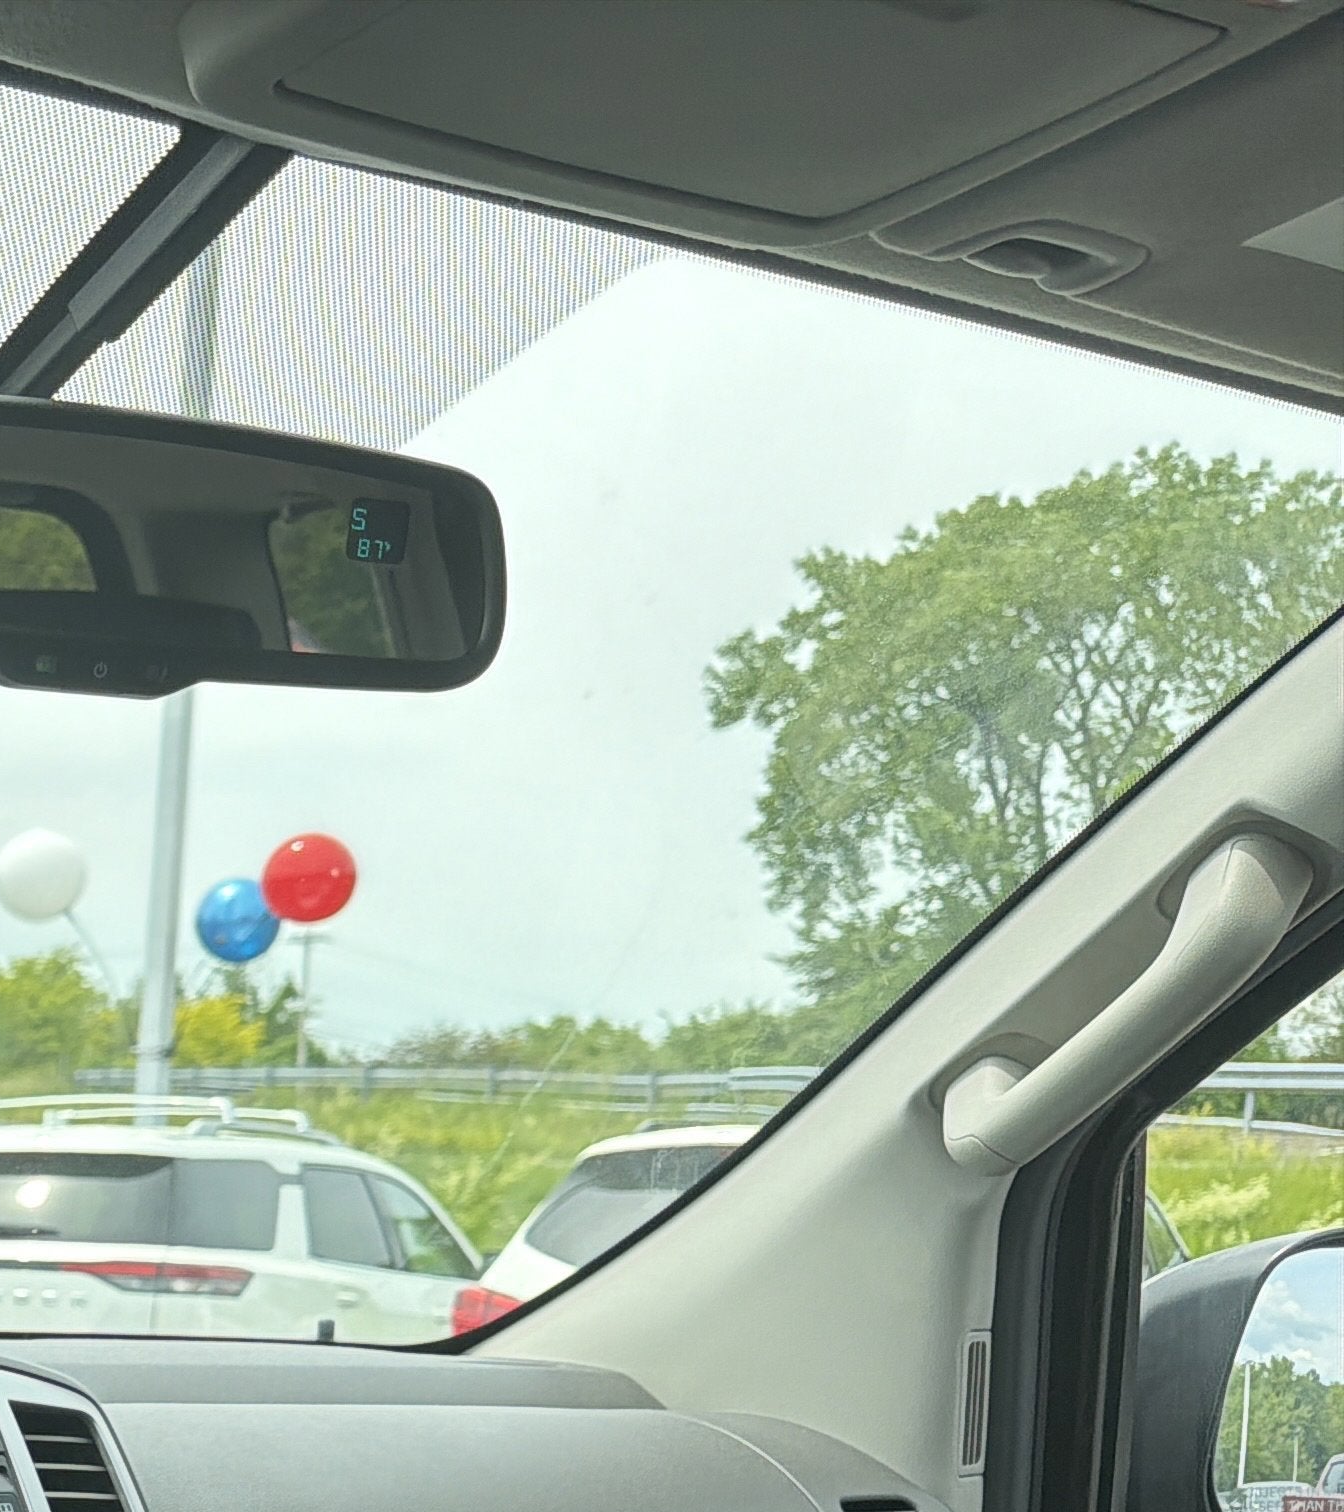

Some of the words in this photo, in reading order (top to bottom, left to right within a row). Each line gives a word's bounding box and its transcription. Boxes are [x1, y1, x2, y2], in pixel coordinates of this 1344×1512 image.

[351, 508, 367, 531] S
[1289, 1500, 1325, 1512] THAN
[1328, 1500, 1344, 1511] TH
